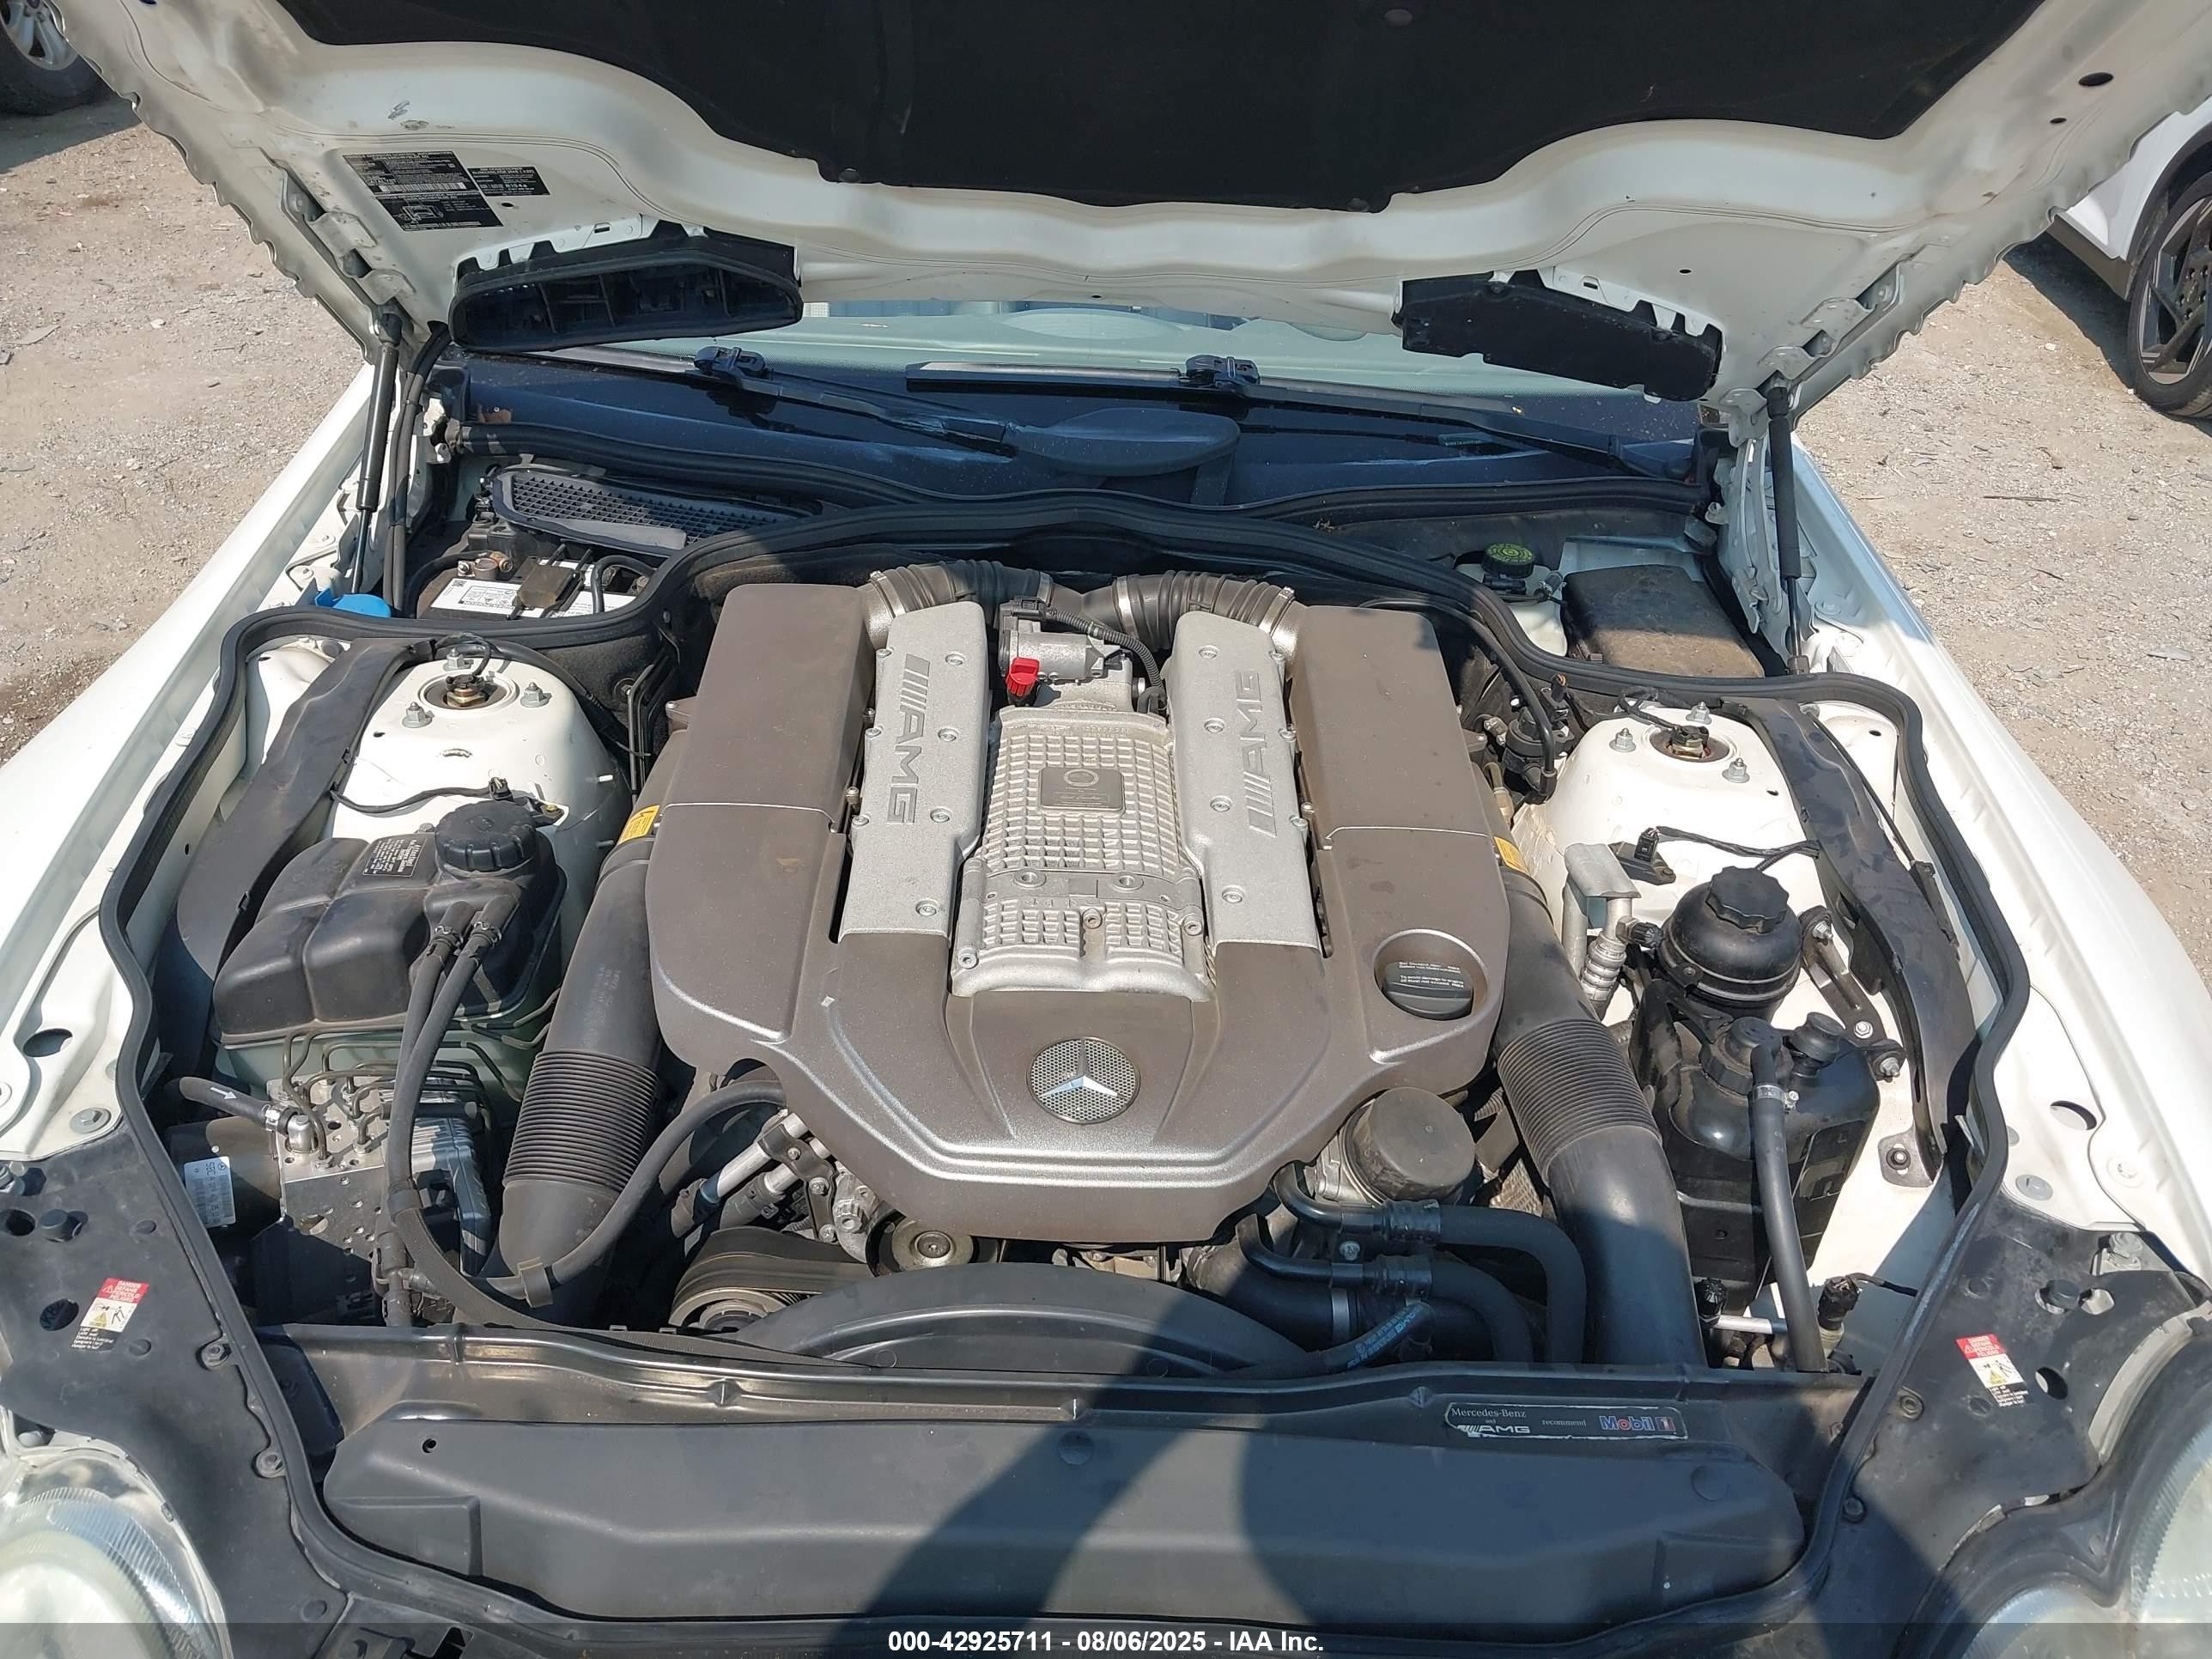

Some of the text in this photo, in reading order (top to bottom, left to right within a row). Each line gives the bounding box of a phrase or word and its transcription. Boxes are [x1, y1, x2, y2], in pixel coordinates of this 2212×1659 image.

[1235, 672, 1268, 778] AMG
[887, 705, 926, 825] AMG
[1451, 1407, 1527, 1418] Mercedes-Benz
[1478, 1425, 1531, 1433] AMG
[1599, 1415, 1656, 1431] Mobil
